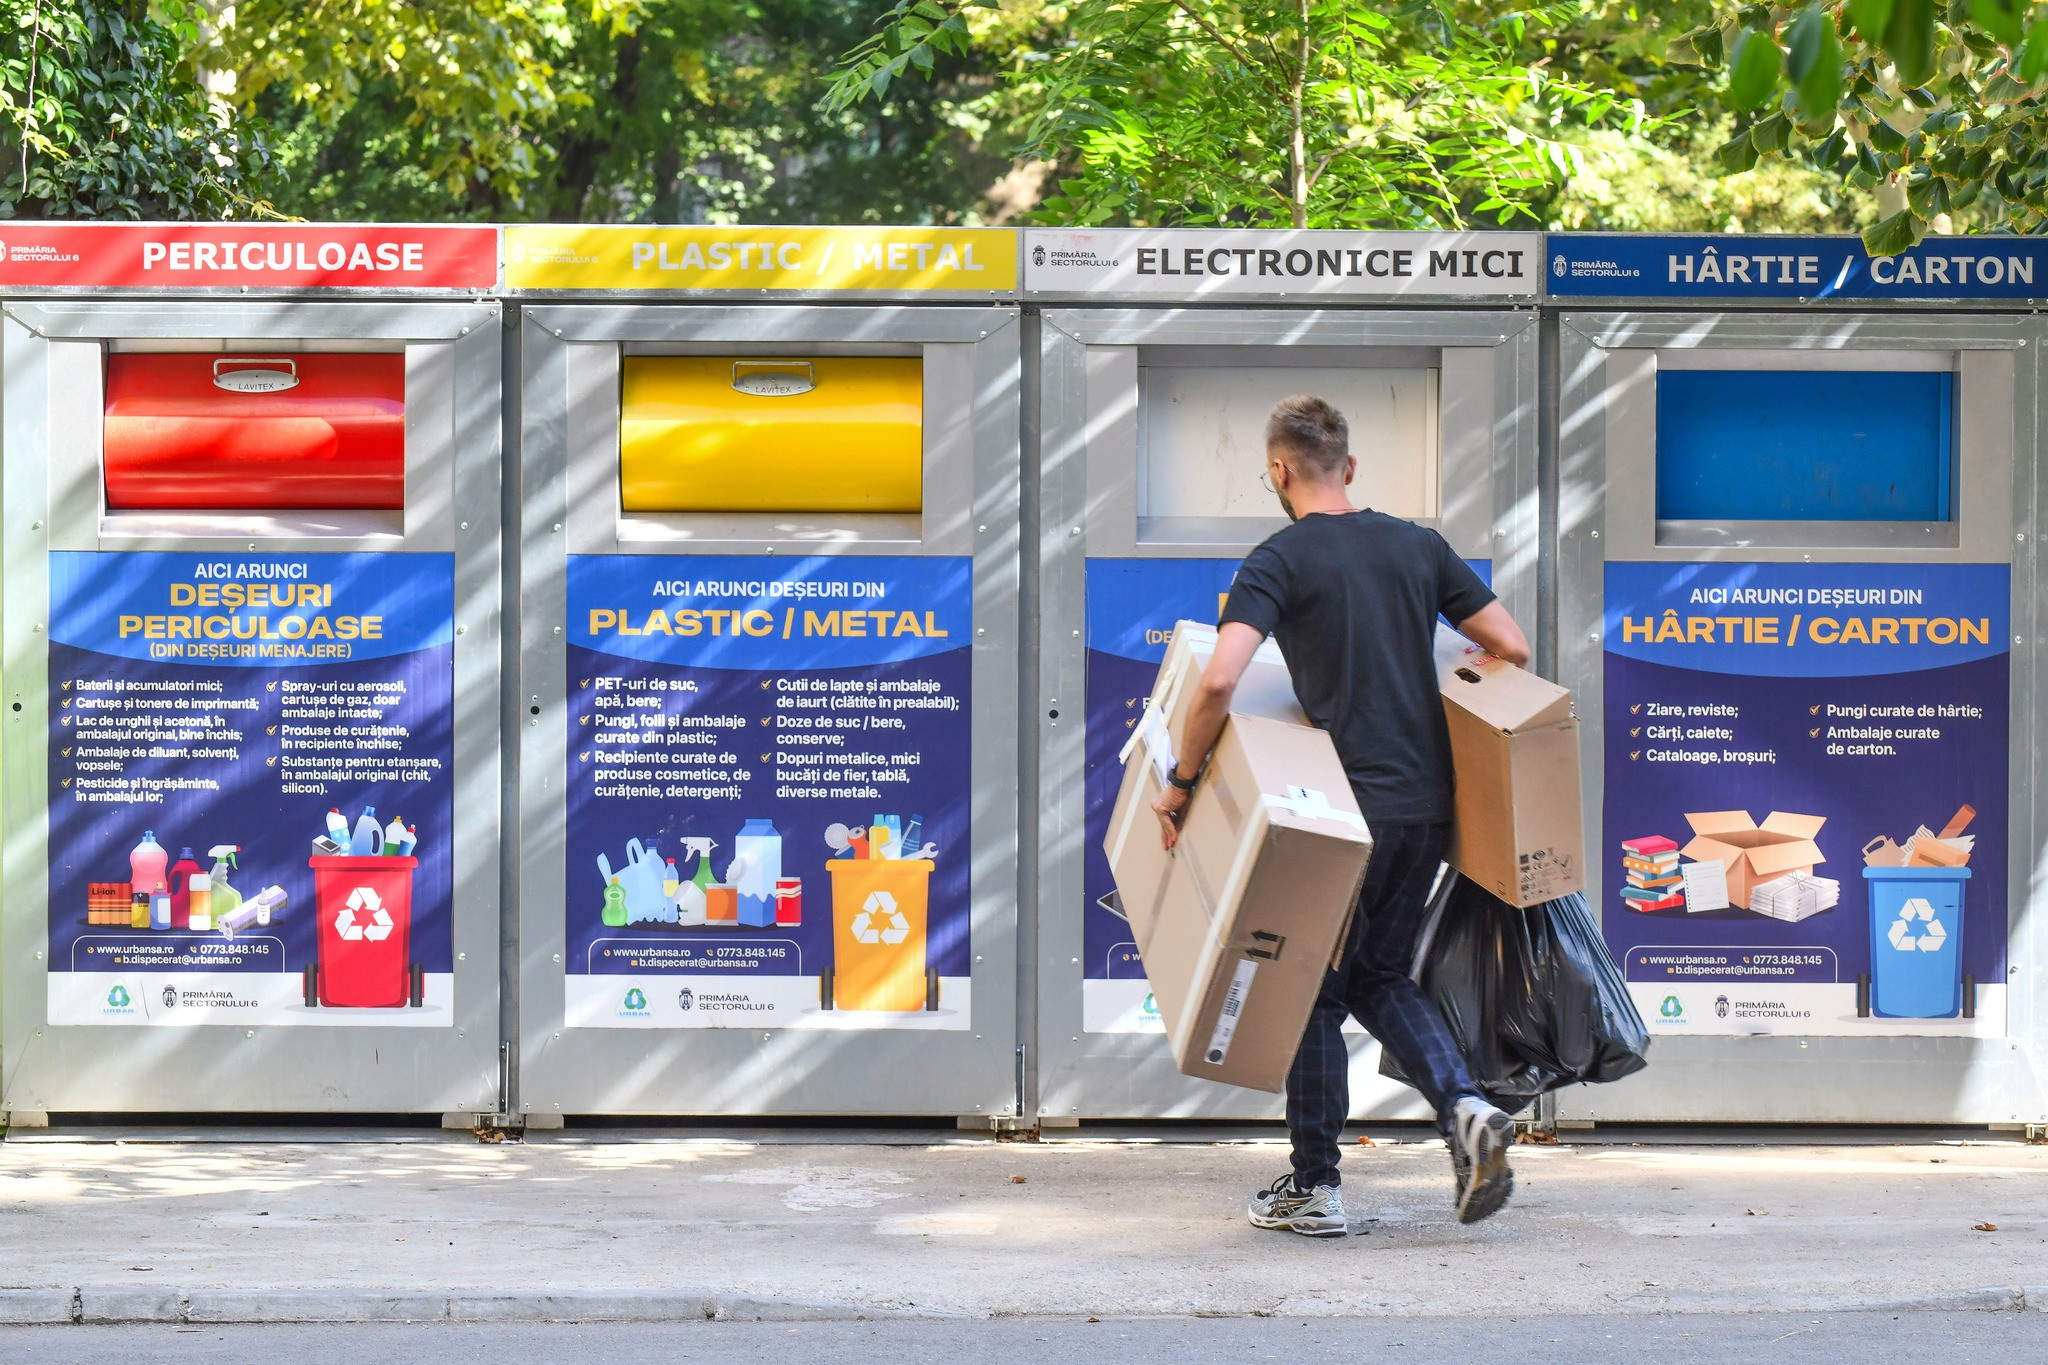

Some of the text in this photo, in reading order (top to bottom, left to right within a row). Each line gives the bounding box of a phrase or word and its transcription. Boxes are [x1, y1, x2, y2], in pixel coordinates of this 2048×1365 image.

[11, 244, 56, 253] PRIMĂRIA
[1052, 250, 1096, 258] PRIMĂRIA
[144, 242, 423, 270] PERICULOASE
[633, 242, 984, 276] PLASTIC / METAL
[1137, 248, 1523, 277] ELECTRONICE MICI
[1572, 260, 1617, 268] PRIMĂRIA
[1669, 246, 2033, 289] HÂRTIE / CARTON
[238, 383, 275, 391] LAVITEX
[756, 386, 791, 394] LAVITEX
[195, 564, 307, 578] AICI ARUNCI
[653, 581, 884, 601] AICI ARUNCI DEȘEURI DIN
[1690, 588, 1922, 608] AICI ARUNCI DEȘEURI DIN
[171, 584, 332, 614] DEȘEURI
[120, 615, 382, 640] PERICULOASE
[590, 608, 948, 639] PLASTIC / METAL
[1624, 609, 1989, 646] HÂRTIE / CARTON
[150, 642, 352, 660] (DIN DEȘEURI MENAJERE)
[76, 680, 222, 693] Baterii și acumulatori mici;
[282, 680, 406, 693] Spray-uri cu aerosoli,
[595, 677, 698, 692] PET-uri de suc,
[76, 697, 259, 711] Cartușe și tonere de imprimantă;
[282, 694, 400, 708] cartușe de gaz, doar
[595, 694, 662, 709] apă, bere;
[777, 695, 959, 710] de iaurt (clătite în prealabil);
[282, 706, 382, 720] ambalaje intacte;
[1647, 703, 1738, 718] Ziare, reviste;
[1828, 704, 1982, 719] Pungi curate de hârtie;
[596, 714, 746, 730] Pungi, folii și ambalaje
[777, 716, 905, 730] Doze de suc / bere,
[76, 728, 242, 742] ambalajul original, bine închis;
[282, 724, 409, 738] Produse de curățenie,
[1647, 726, 1732, 742] Cărți, caiete;
[1827, 726, 1940, 741] Ambalaje curate
[595, 731, 716, 746] curate din plastic;
[777, 735, 844, 746] conserve;
[76, 746, 239, 760] Ambalaje de diluant, solvenți,
[595, 750, 737, 765] Recipiente curate de
[777, 752, 920, 766] Dopuri metalice, mici
[1647, 749, 1776, 765] Cataloage, broșuri;
[282, 756, 441, 769] Substanțe pentru etanșare,
[281, 769, 431, 782] în ambalajul original (chit,
[595, 768, 750, 782] produse cosmetice, de
[777, 768, 909, 784] bucăți de fier, tablă,
[282, 782, 328, 795] silicon).
[595, 784, 741, 800] curățenie, detergenți;
[776, 785, 881, 798] diverse metale.
[97, 945, 174, 954] www.urbansa.ro
[200, 945, 269, 954] 0773.848.145
[614, 948, 690, 956] www.urbansa.ro
[717, 948, 785, 957] 0773.848.145
[123, 955, 242, 965] b.dispecerat@urbansa.ro
[640, 958, 758, 968] b.dispecerat@urbansa.ro
[1650, 955, 1727, 964] www.urbansa.ro
[1753, 955, 1822, 964] 0773.848.145
[1676, 965, 1794, 976] b.dispecerat@urbansa.ro
[183, 990, 233, 998] PRIMĂRIA
[700, 993, 749, 1001] PRIMĂRIA
[1736, 1000, 1785, 1008] PRIMĂRIA
